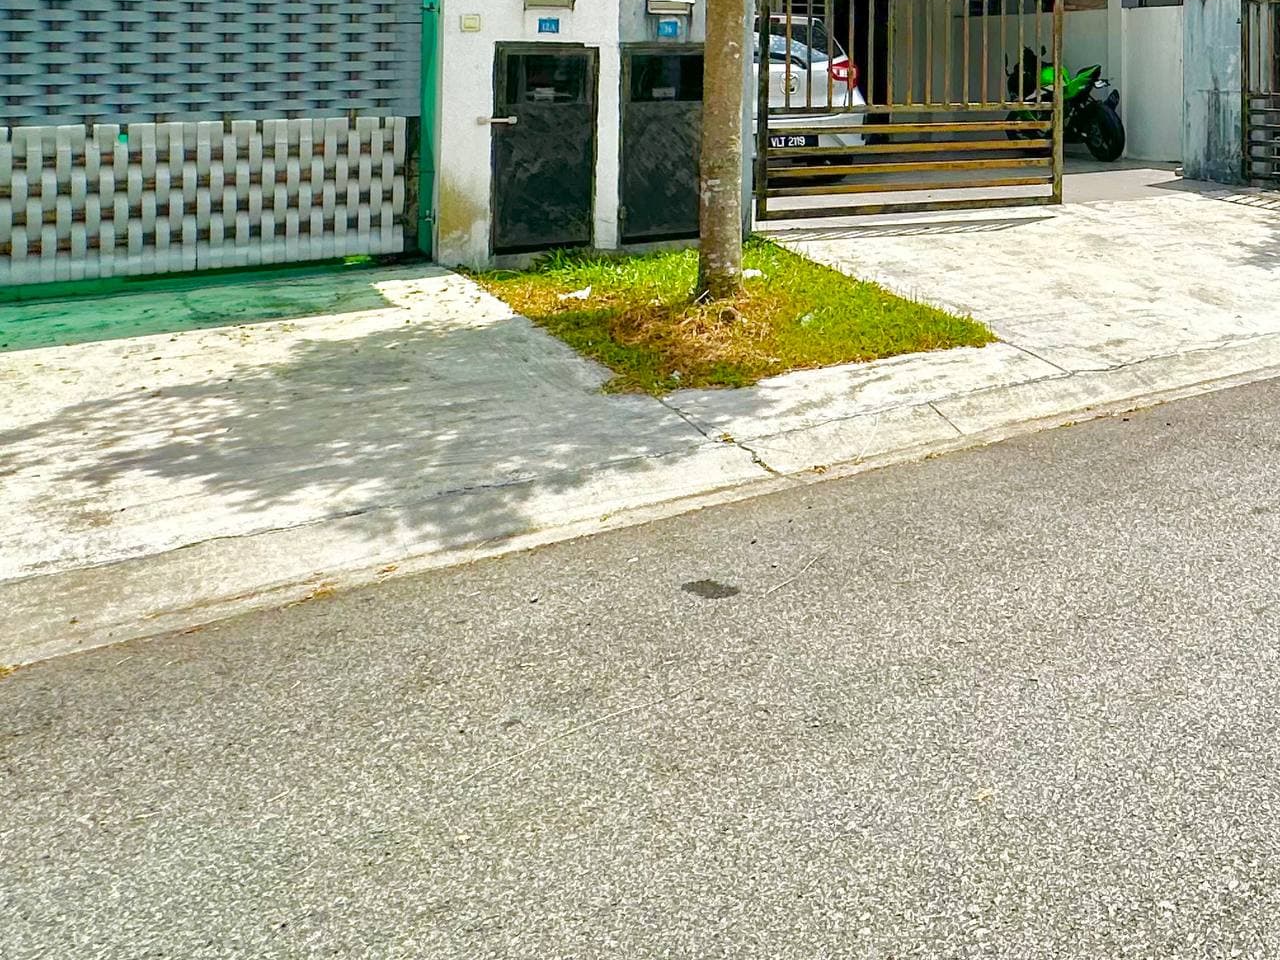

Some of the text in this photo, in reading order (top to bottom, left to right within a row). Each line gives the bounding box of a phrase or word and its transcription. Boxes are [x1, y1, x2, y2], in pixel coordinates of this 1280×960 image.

[540, 22, 557, 32] 12A
[770, 136, 806, 147] VLT 2119
